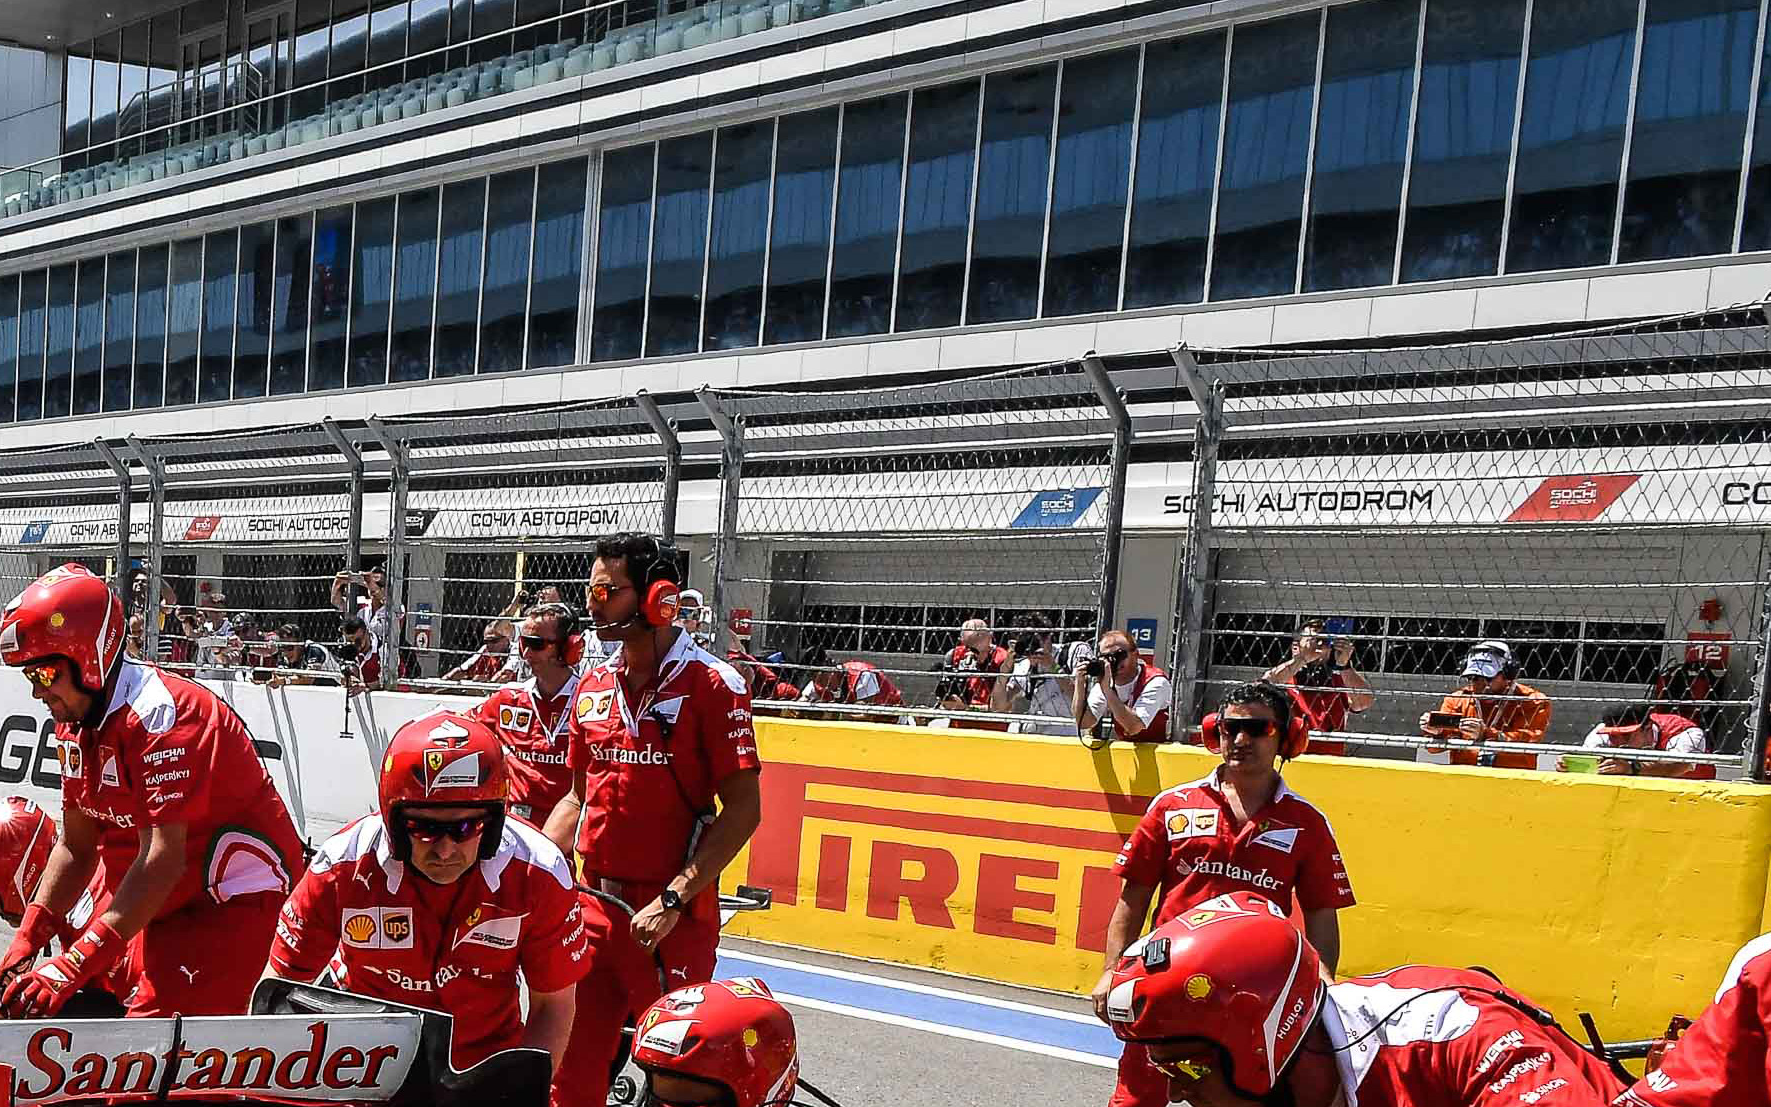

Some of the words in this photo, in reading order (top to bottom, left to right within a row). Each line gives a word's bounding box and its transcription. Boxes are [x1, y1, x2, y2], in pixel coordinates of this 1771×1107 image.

[1255, 490, 1434, 512] AUTODROM
[1549, 489, 1597, 499] SOCHI
[248, 518, 285, 532] SOCHI
[471, 513, 516, 527] СОЧИ
[520, 510, 619, 528] АВТОДРОМ
[70, 524, 100, 536] СОЧИ
[1131, 628, 1152, 641] 13
[1694, 644, 1722, 660] 12
[589, 743, 674, 766] Santander
[1192, 857, 1284, 891] Santander
[385, 921, 408, 938] ups
[1277, 997, 1306, 1040] HUBLOT
[17, 1020, 401, 1101] Santander
